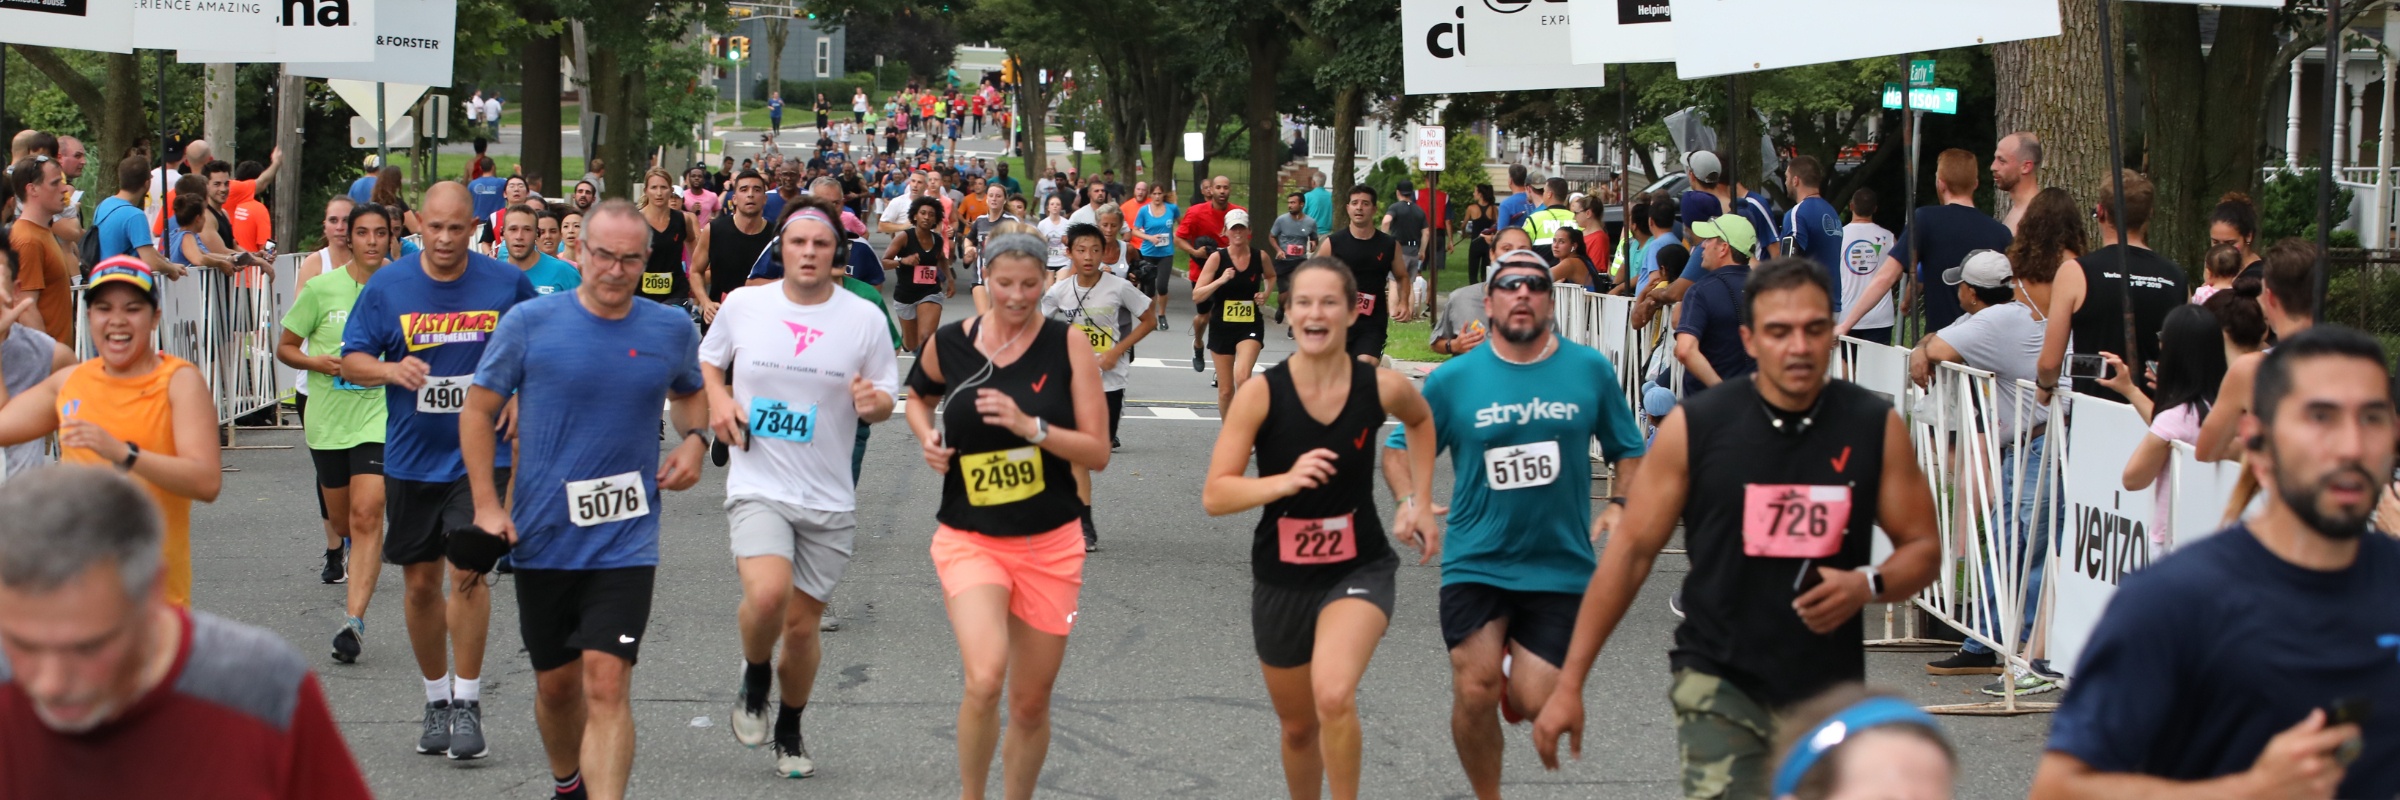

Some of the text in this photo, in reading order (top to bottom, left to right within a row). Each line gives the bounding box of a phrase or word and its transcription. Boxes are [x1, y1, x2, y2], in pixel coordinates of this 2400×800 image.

[134, 0, 261, 14] RIENCE AMAZING
[1638, 4, 1670, 17] Helping
[376, 35, 439, 50] & FORSTER
[1911, 64, 1927, 83] Early
[1885, 86, 1956, 109] Harison St
[1420, 139, 1443, 148] PARKING
[1427, 130, 1436, 138] NO
[645, 277, 671, 289] 2099
[1226, 305, 1252, 317] 2129
[409, 312, 496, 338] FAST TIMES
[420, 333, 430, 344] AT
[752, 360, 846, 378] HEALTH HYGIENE HOME
[755, 408, 808, 437] 7344
[1474, 396, 1580, 429] stryker
[971, 460, 1035, 492] 2499
[1493, 454, 1553, 485] 5156
[577, 486, 639, 520] 5076
[1767, 502, 1828, 538] 726
[1295, 529, 1344, 557] 222
[2074, 489, 2150, 587] verizo
